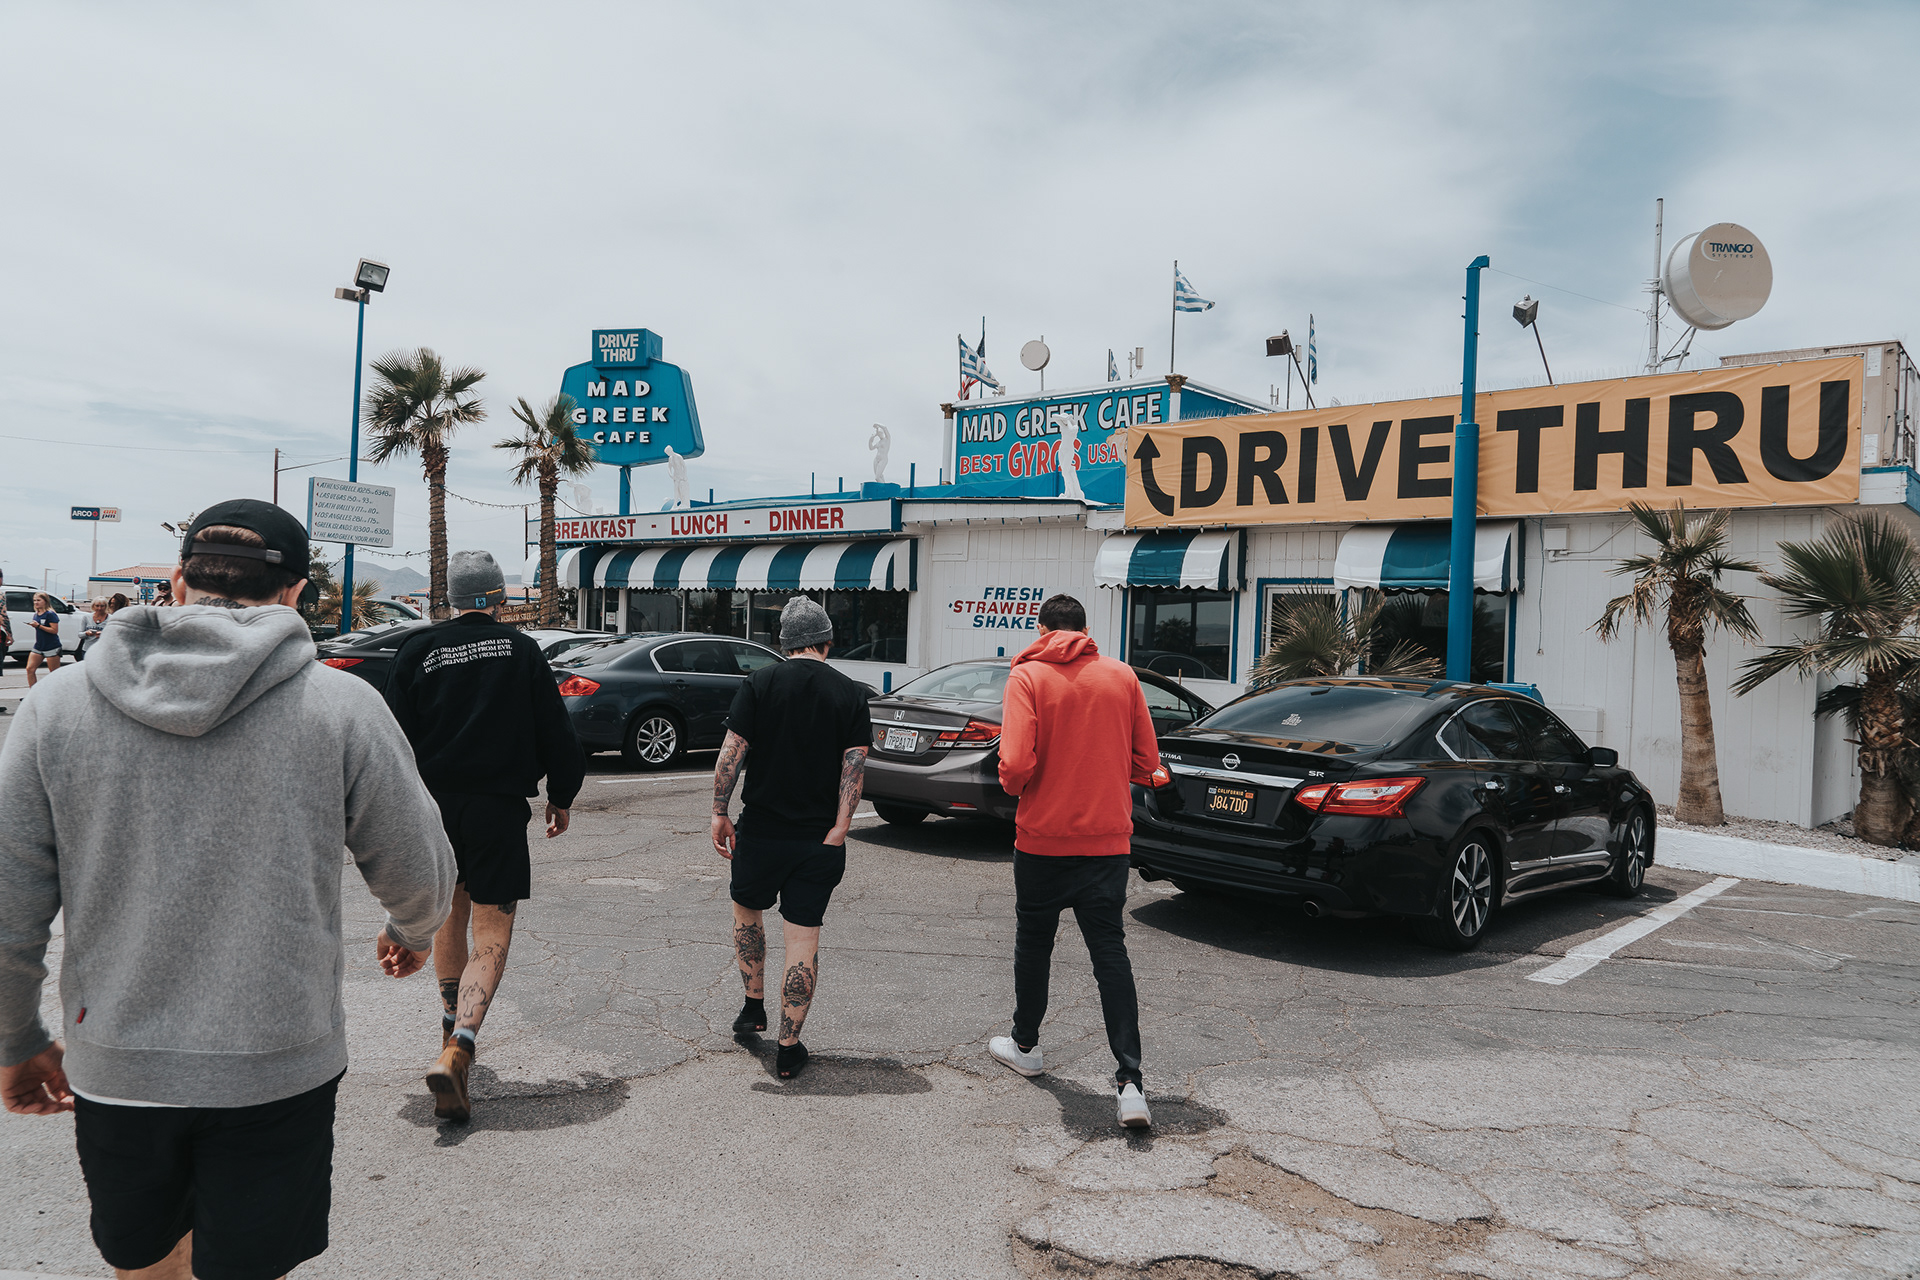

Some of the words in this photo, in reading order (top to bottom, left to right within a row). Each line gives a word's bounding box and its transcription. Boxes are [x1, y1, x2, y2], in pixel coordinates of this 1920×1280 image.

[1709, 242, 1753, 253] TRANGO
[598, 334, 639, 348] DRIVE
[601, 348, 636, 362] THRU
[587, 380, 651, 397] MAD
[571, 407, 668, 424] GREEK
[961, 411, 1007, 444] MAD
[1097, 391, 1162, 430] CAFE
[593, 431, 650, 444] CAFE
[1179, 414, 1454, 509] DRIVE
[1496, 379, 1850, 495] THRU
[960, 454, 1004, 475] BEST
[1088, 442, 1119, 464] USA
[320, 482, 340, 490] ATHENS
[555, 518, 636, 540] BREAKFAST
[671, 514, 727, 535] LUNCH
[769, 507, 844, 531] DINNER
[374, 527, 390, 535] 6300
[983, 587, 1044, 601] FRESH
[953, 600, 1040, 616] STRAWBE
[440, 645, 467, 653] DELIVER
[477, 639, 496, 647] FROM
[441, 651, 468, 659] DELIVER
[478, 645, 497, 653] FROM
[441, 657, 469, 666] DELIVER
[479, 651, 497, 659] FROM
[1158, 751, 1182, 760] ALTIMA
[1308, 770, 1325, 778] SR
[1217, 788, 1244, 796] CALIFORNIA
